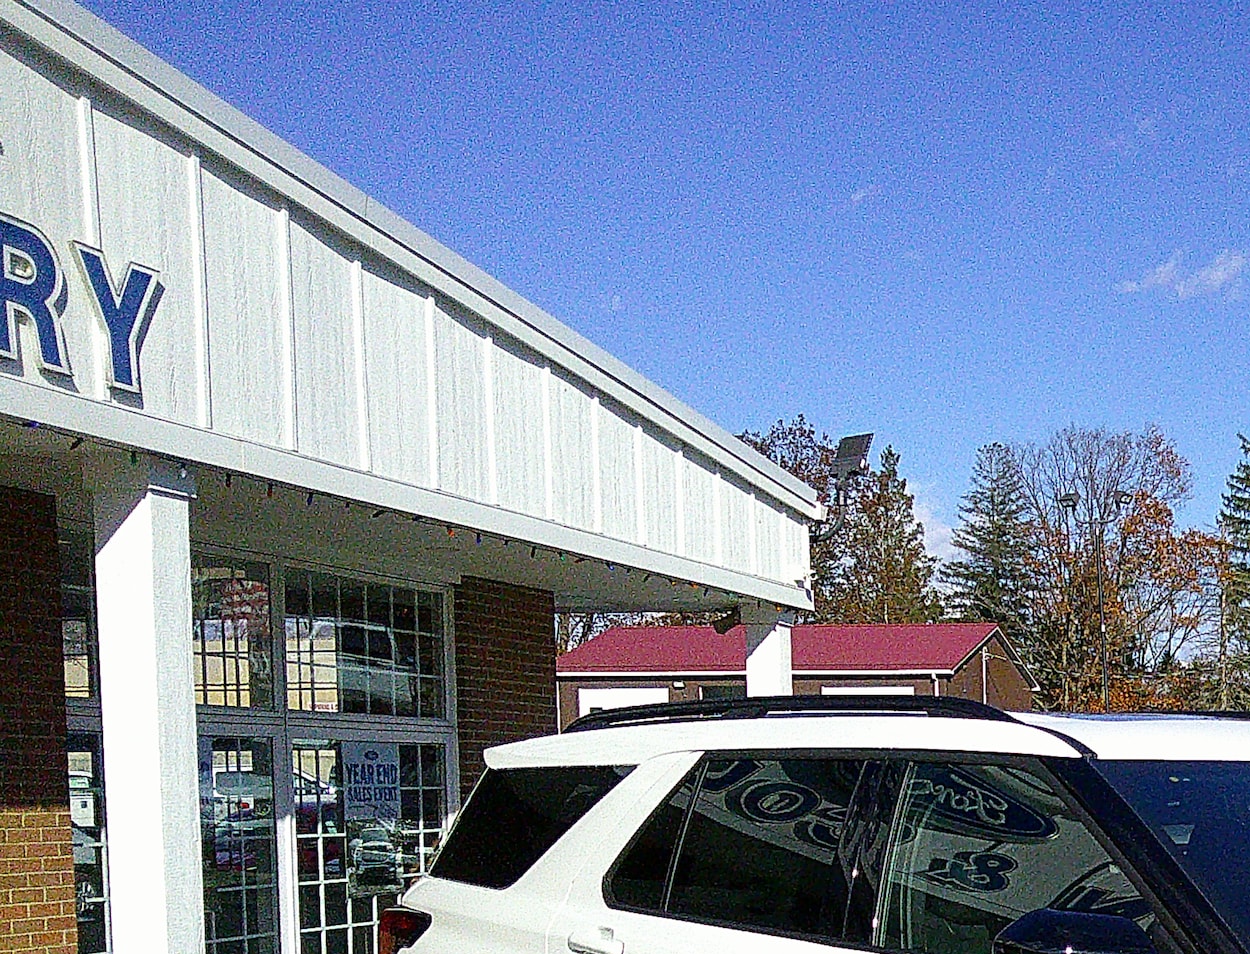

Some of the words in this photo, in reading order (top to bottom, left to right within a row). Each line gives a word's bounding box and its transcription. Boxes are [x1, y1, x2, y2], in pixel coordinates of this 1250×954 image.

[345, 763, 374, 784] YEAR
[376, 763, 398, 784] END
[347, 786, 373, 802] SALES
[374, 786, 398, 801] EVENT
